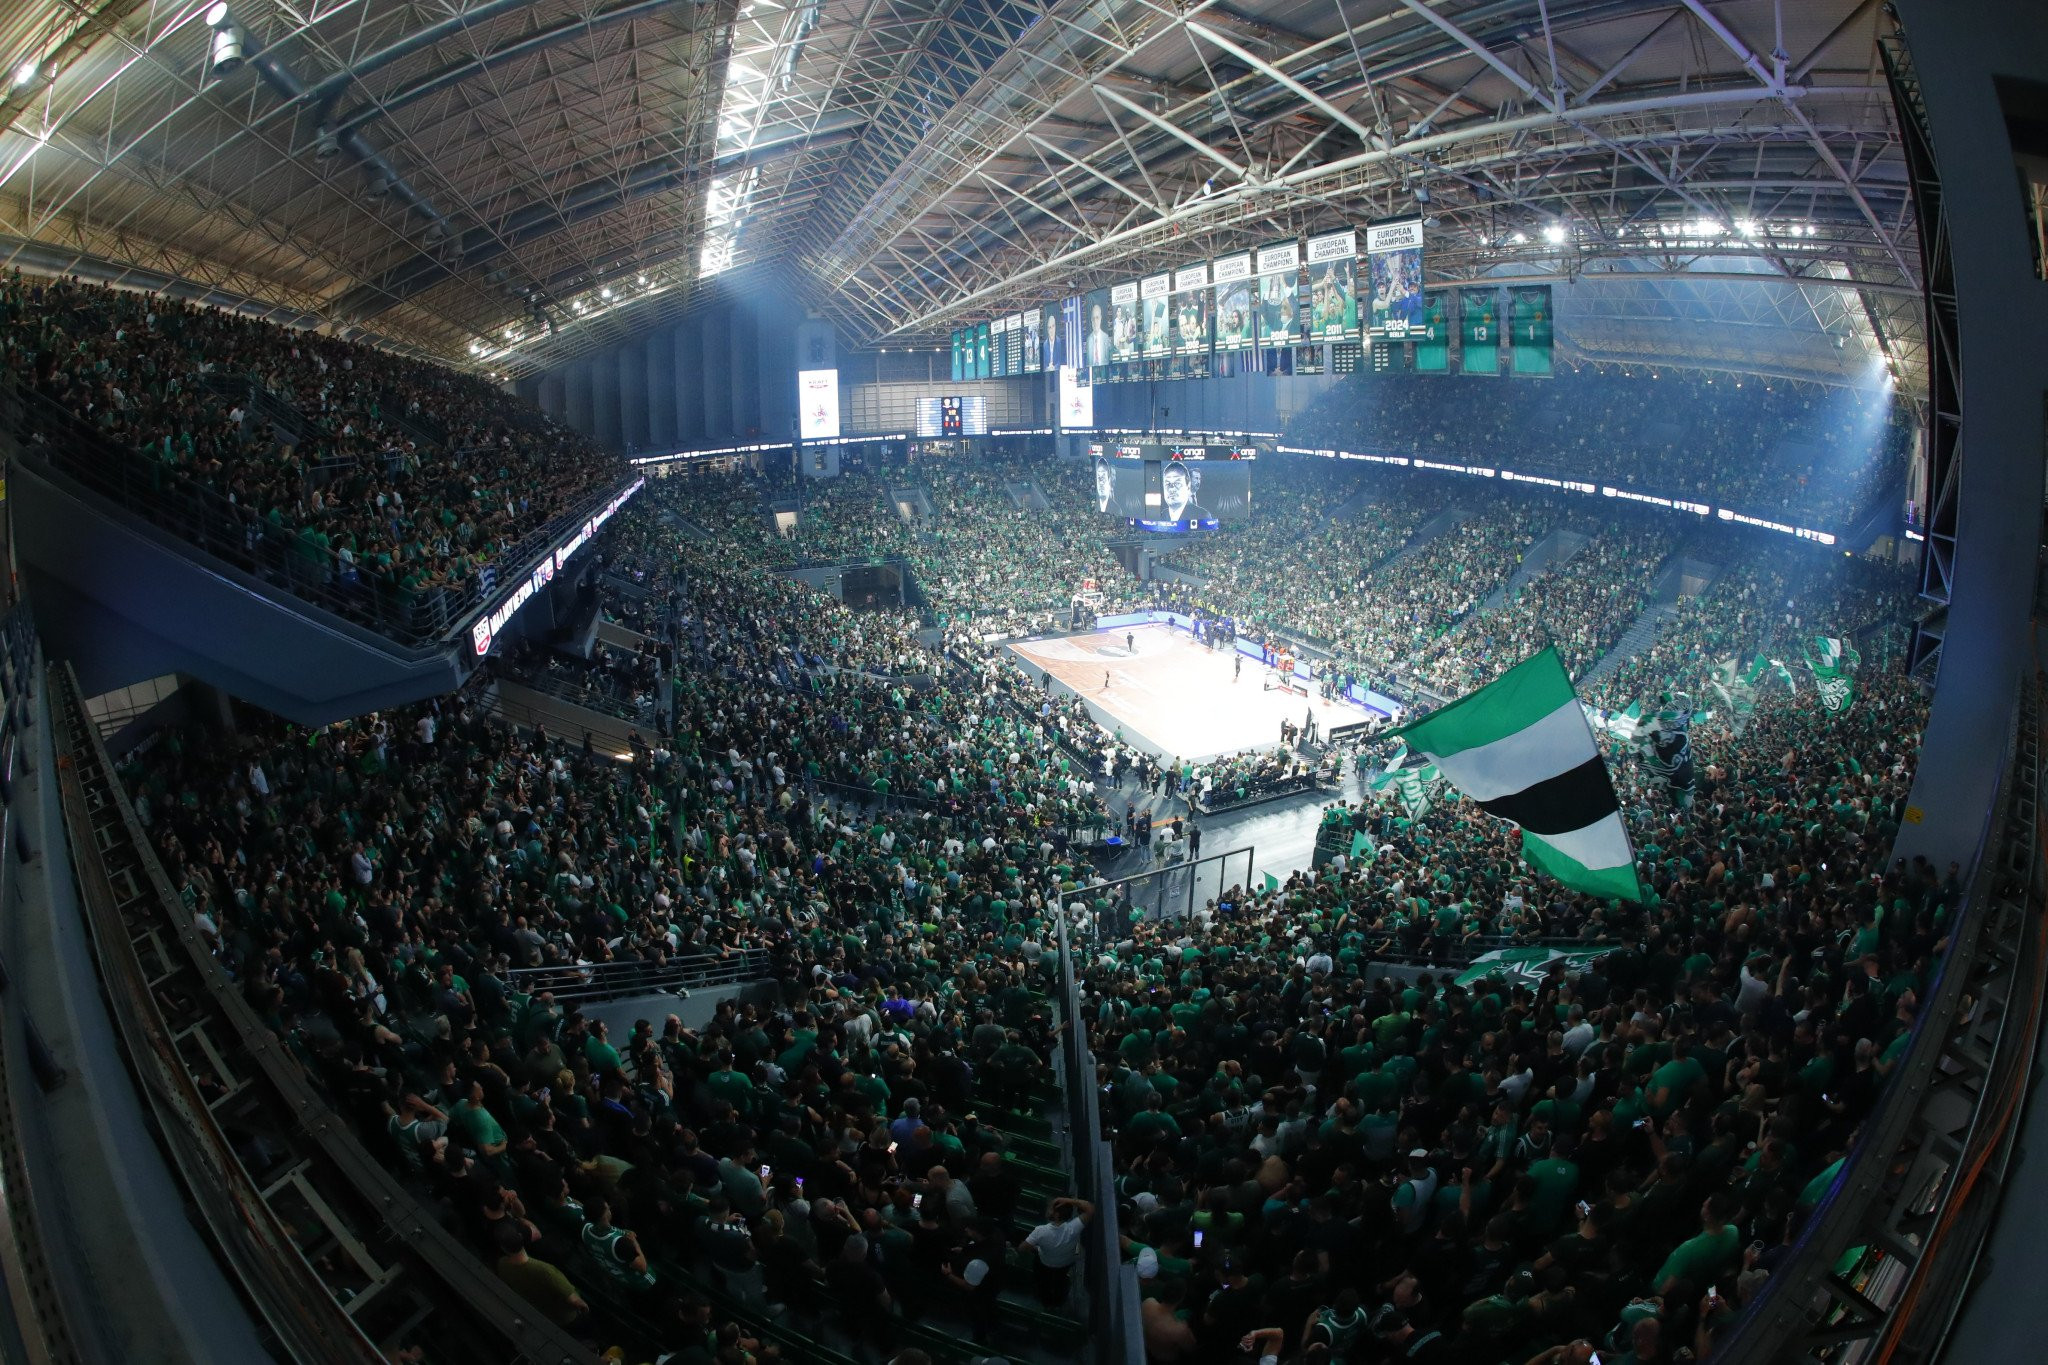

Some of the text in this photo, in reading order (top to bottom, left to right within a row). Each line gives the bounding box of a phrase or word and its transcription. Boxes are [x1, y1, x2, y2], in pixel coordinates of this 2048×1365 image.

[1377, 227, 1412, 239] EUROPEAN
[1315, 238, 1347, 251] EUROPEAN
[1375, 235, 1415, 248] CHAMPIONS
[1264, 251, 1291, 262] EUROPEAN
[1314, 246, 1349, 259] CHAMPIONS
[1220, 260, 1244, 271] EUROPEAN
[1263, 258, 1293, 269] CHAMPIONS
[1180, 272, 1202, 282] EUROPEAN
[1218, 267, 1246, 278] CHAMPIONS
[1179, 278, 1203, 288] CHAMPIONS
[1325, 324, 1342, 335] 2011
[1385, 319, 1409, 331] 2024
[1270, 330, 1289, 341] 2009
[1426, 327, 1435, 341] 4
[1473, 326, 1487, 341] 13
[1528, 325, 1534, 340] 1
[966, 349, 973, 364] 13
[980, 346, 985, 360] 4
